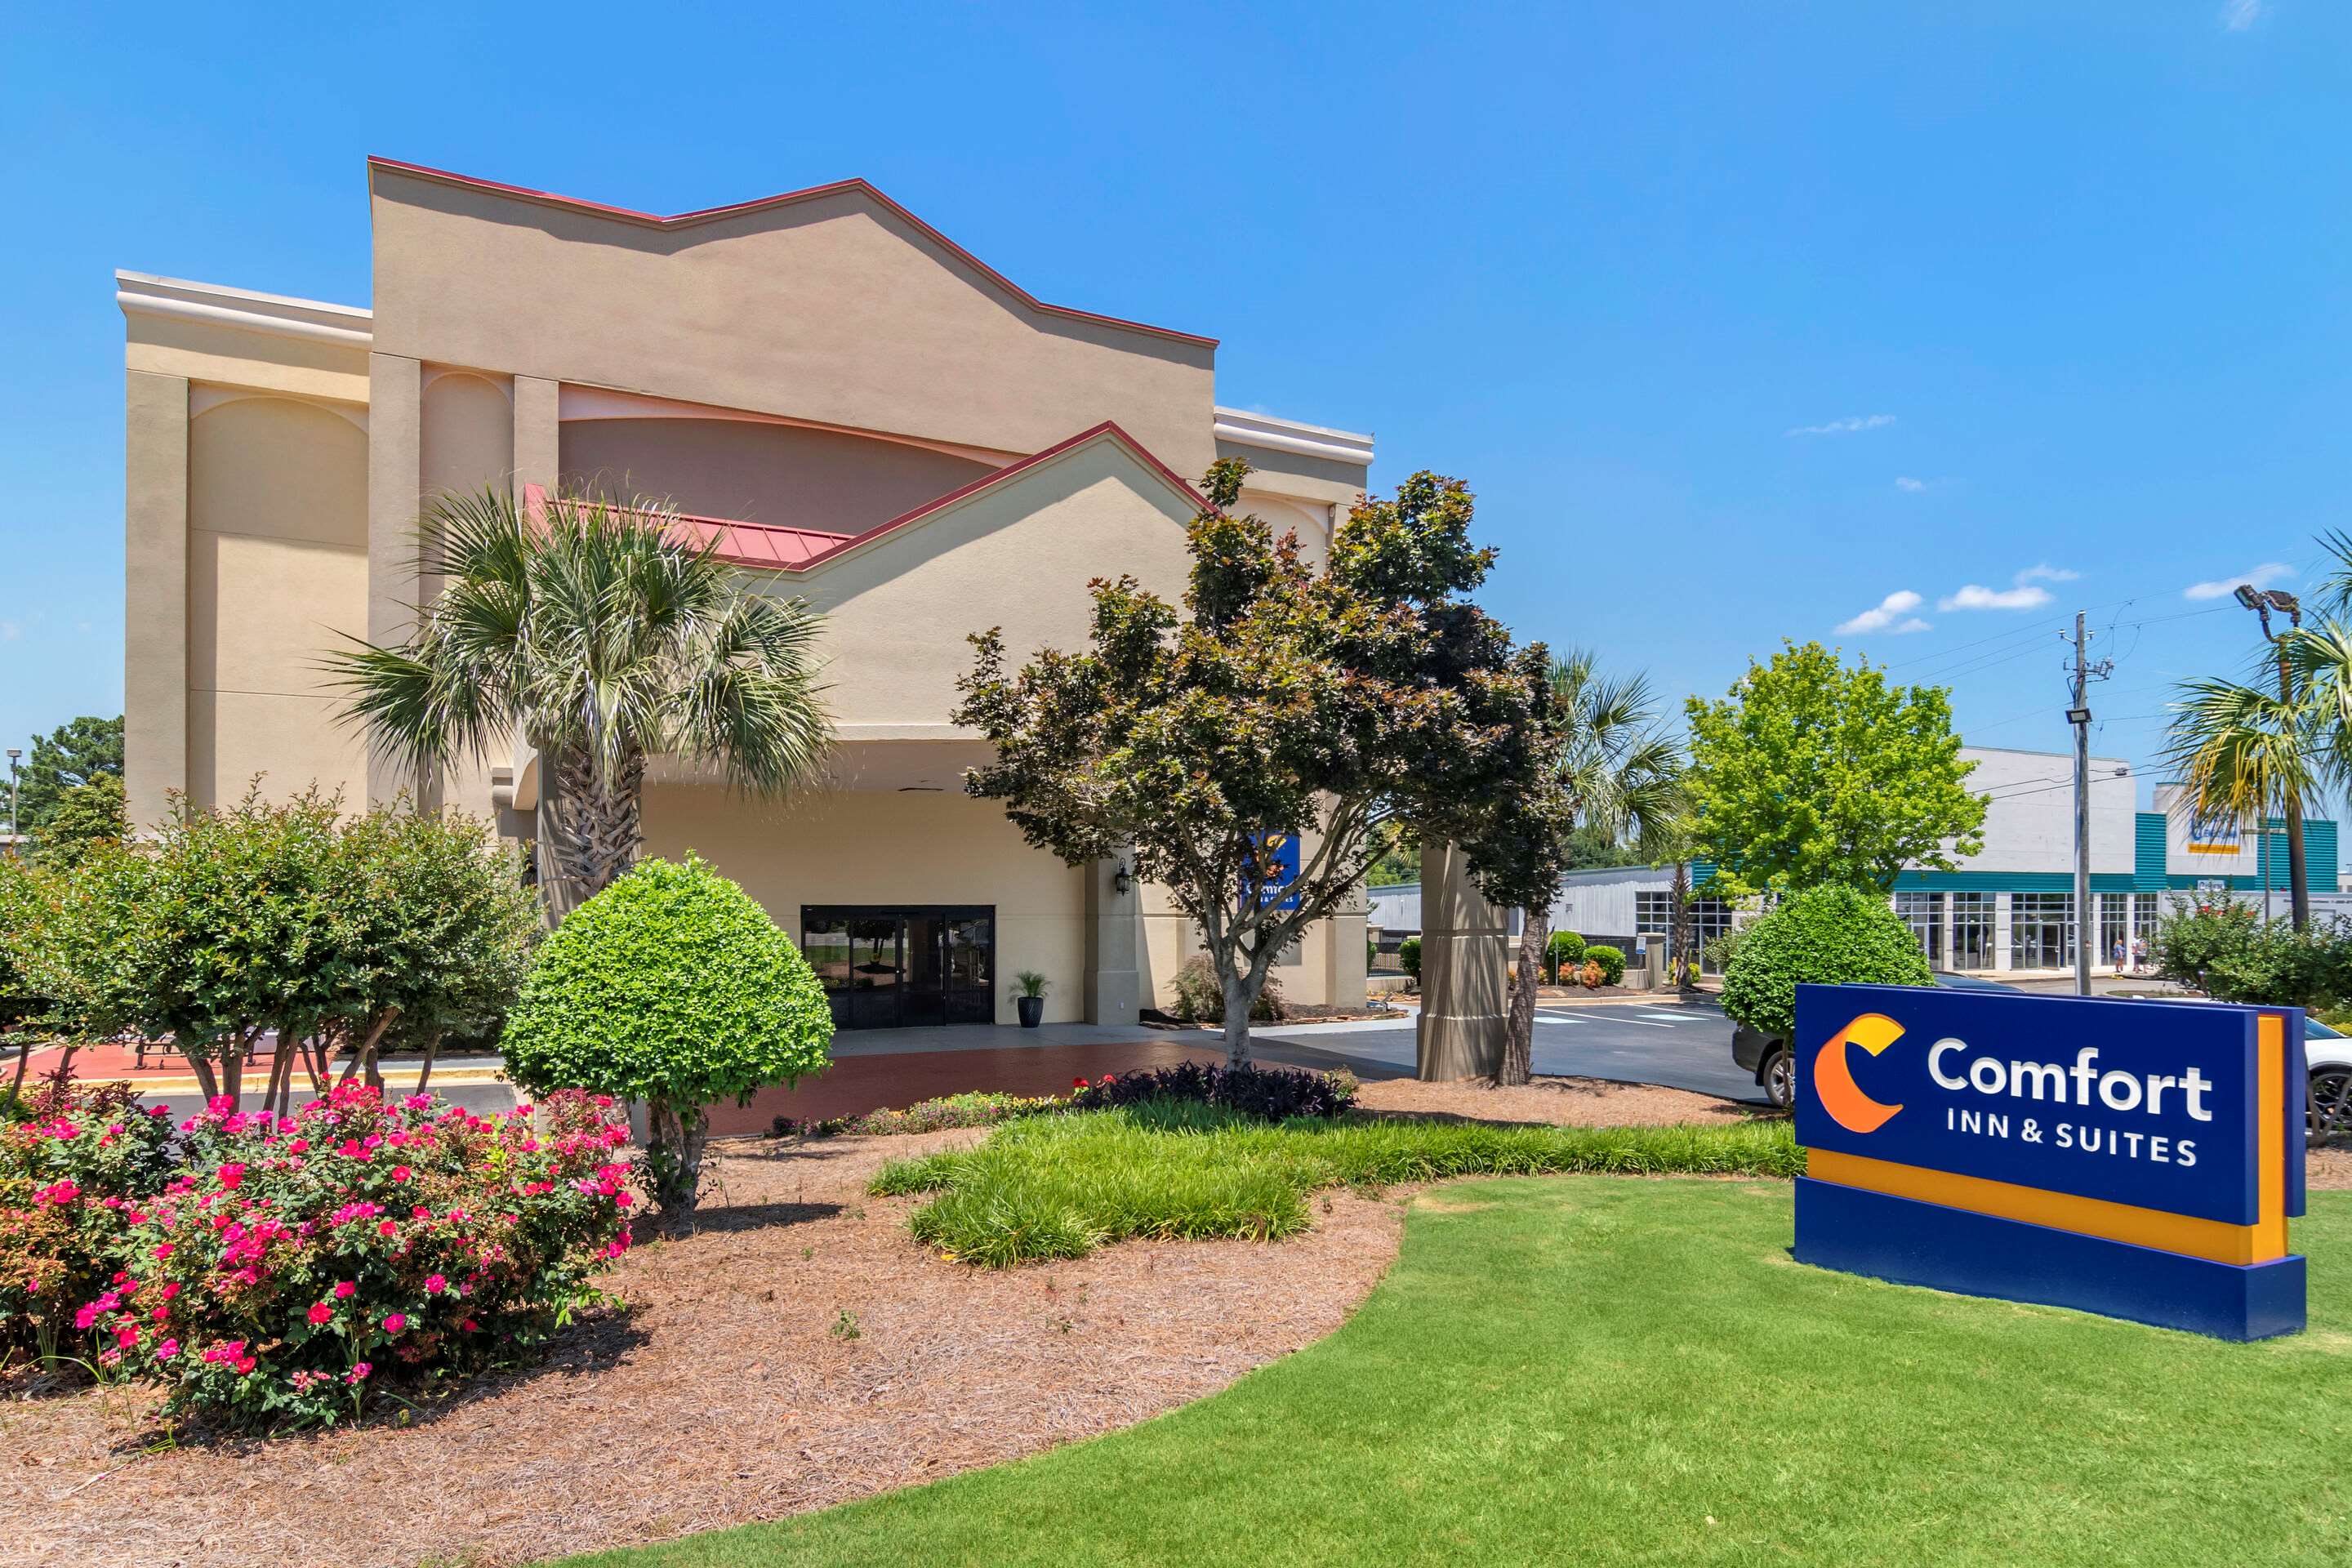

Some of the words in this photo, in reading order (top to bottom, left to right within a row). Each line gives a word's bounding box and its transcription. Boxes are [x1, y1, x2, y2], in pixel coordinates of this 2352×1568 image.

[1927, 1037, 2213, 1122] Comfort
[1947, 1107, 2009, 1139] INN
[2020, 1118, 2044, 1144] &
[2055, 1123, 2198, 1167] SUITES
